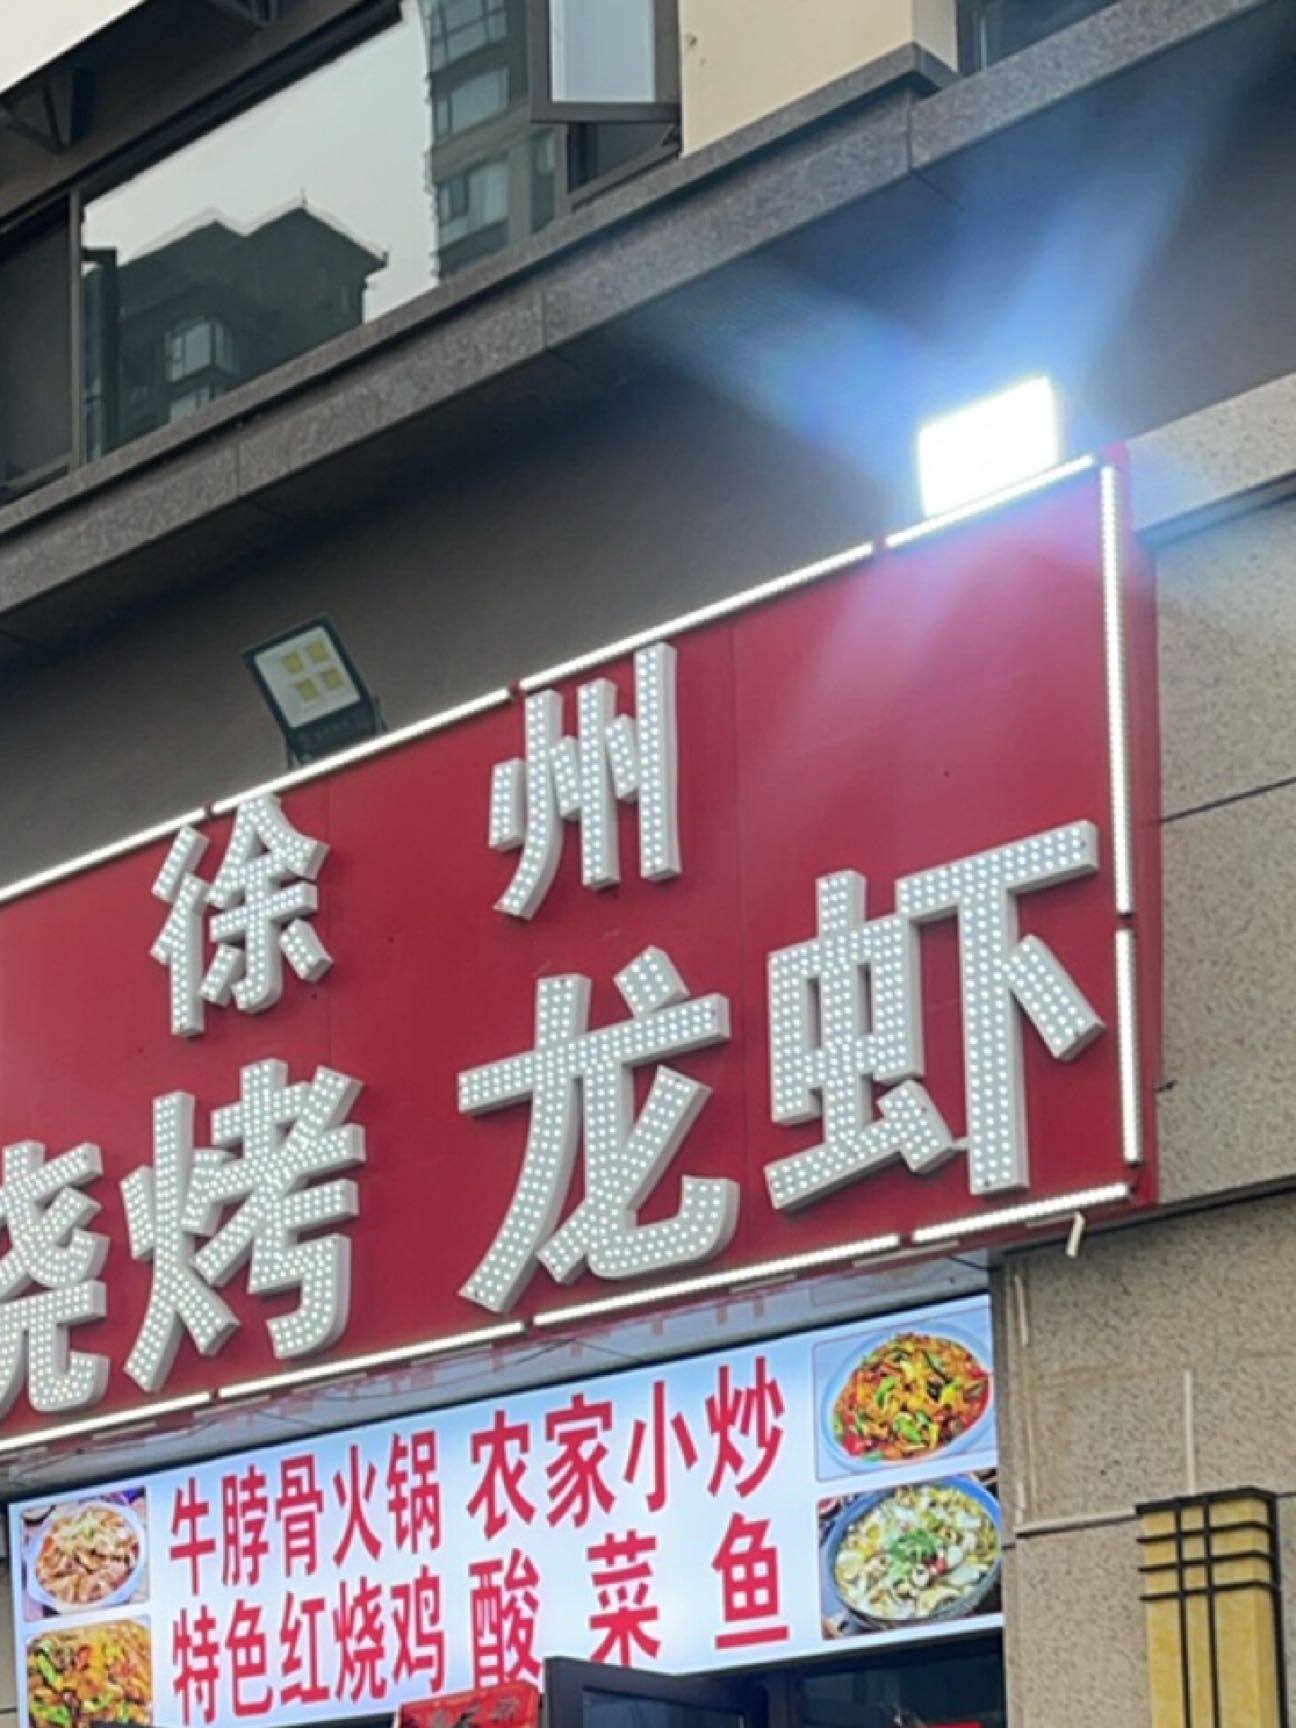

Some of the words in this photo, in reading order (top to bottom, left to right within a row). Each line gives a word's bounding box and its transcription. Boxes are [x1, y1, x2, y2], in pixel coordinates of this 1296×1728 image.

[458, 819, 1106, 1311] 龙虾
[169, 1429, 442, 1596] 牛脖骨火锅
[467, 1356, 785, 1541] 农家小炒
[173, 1564, 445, 1728] 特色红烧鸡
